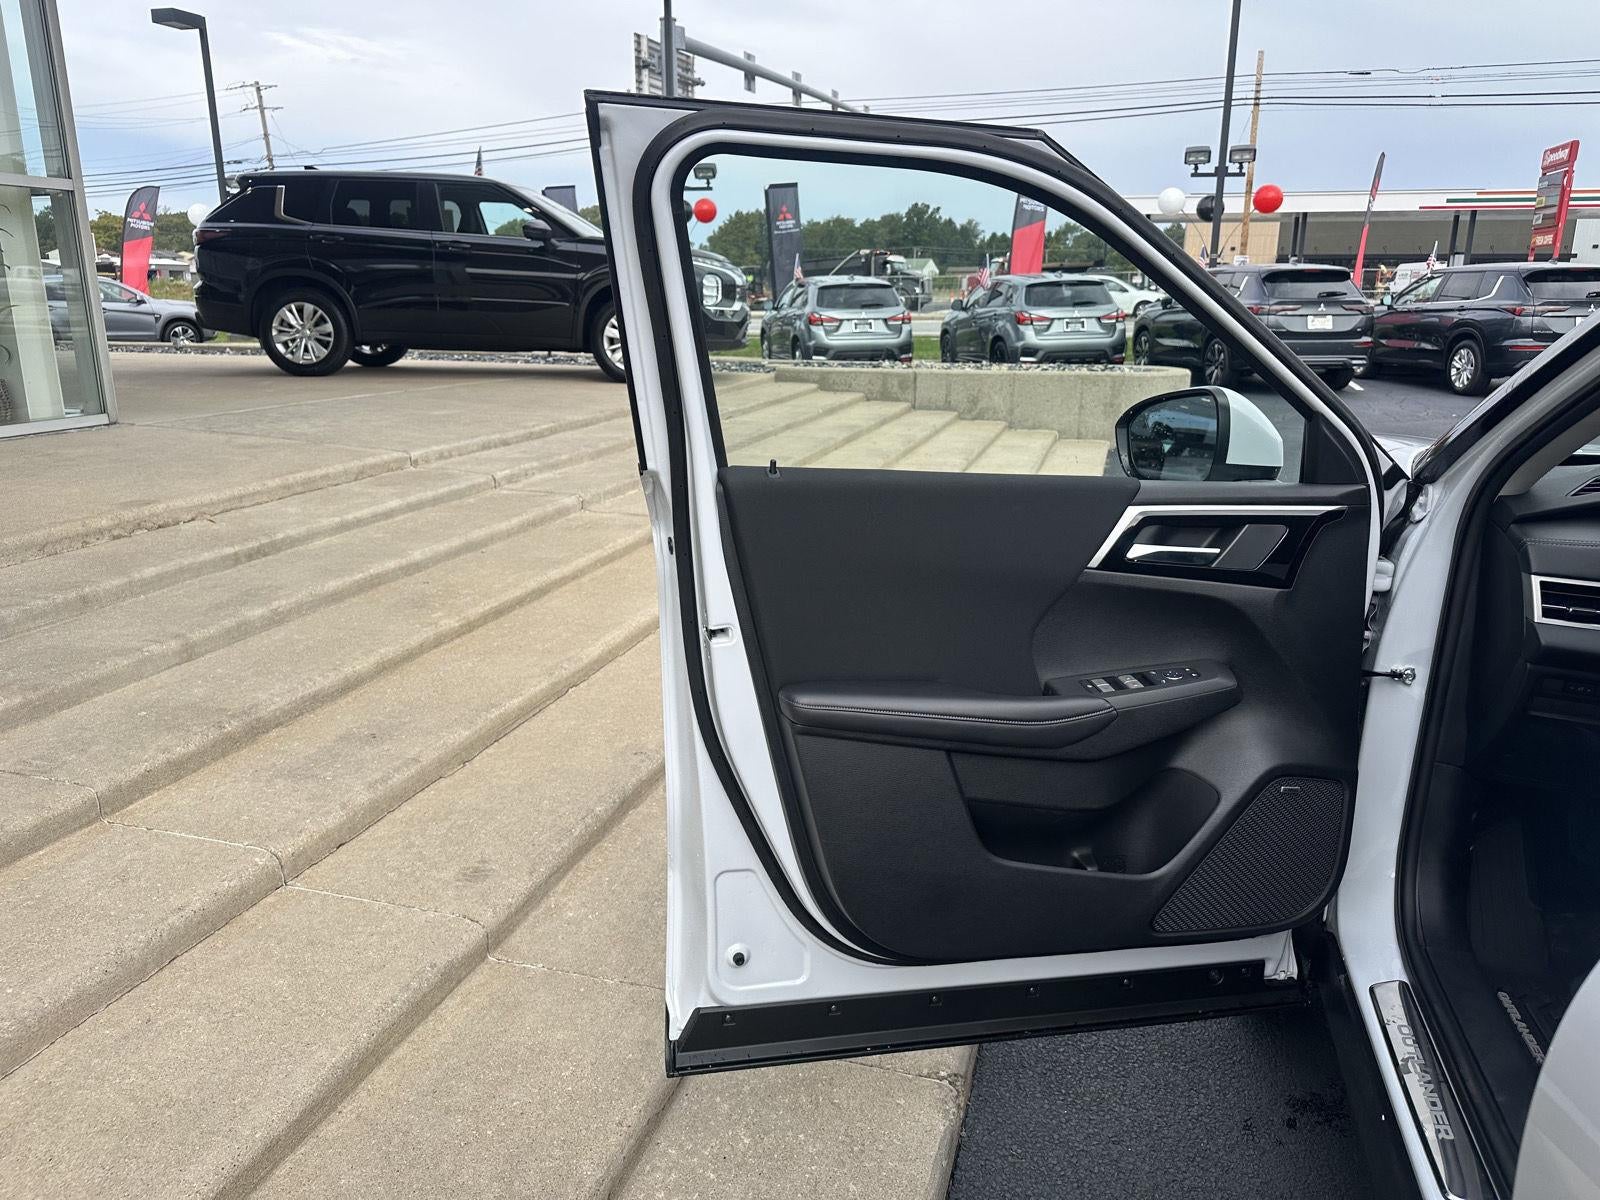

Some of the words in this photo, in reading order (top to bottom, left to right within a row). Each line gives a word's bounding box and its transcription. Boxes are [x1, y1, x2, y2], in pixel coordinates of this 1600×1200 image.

[1543, 148, 1569, 165] Speedway
[127, 217, 154, 227] MITSUBISHI
[130, 223, 151, 231] MOTORS
[1397, 1024, 1454, 1140] OUTLANDER
